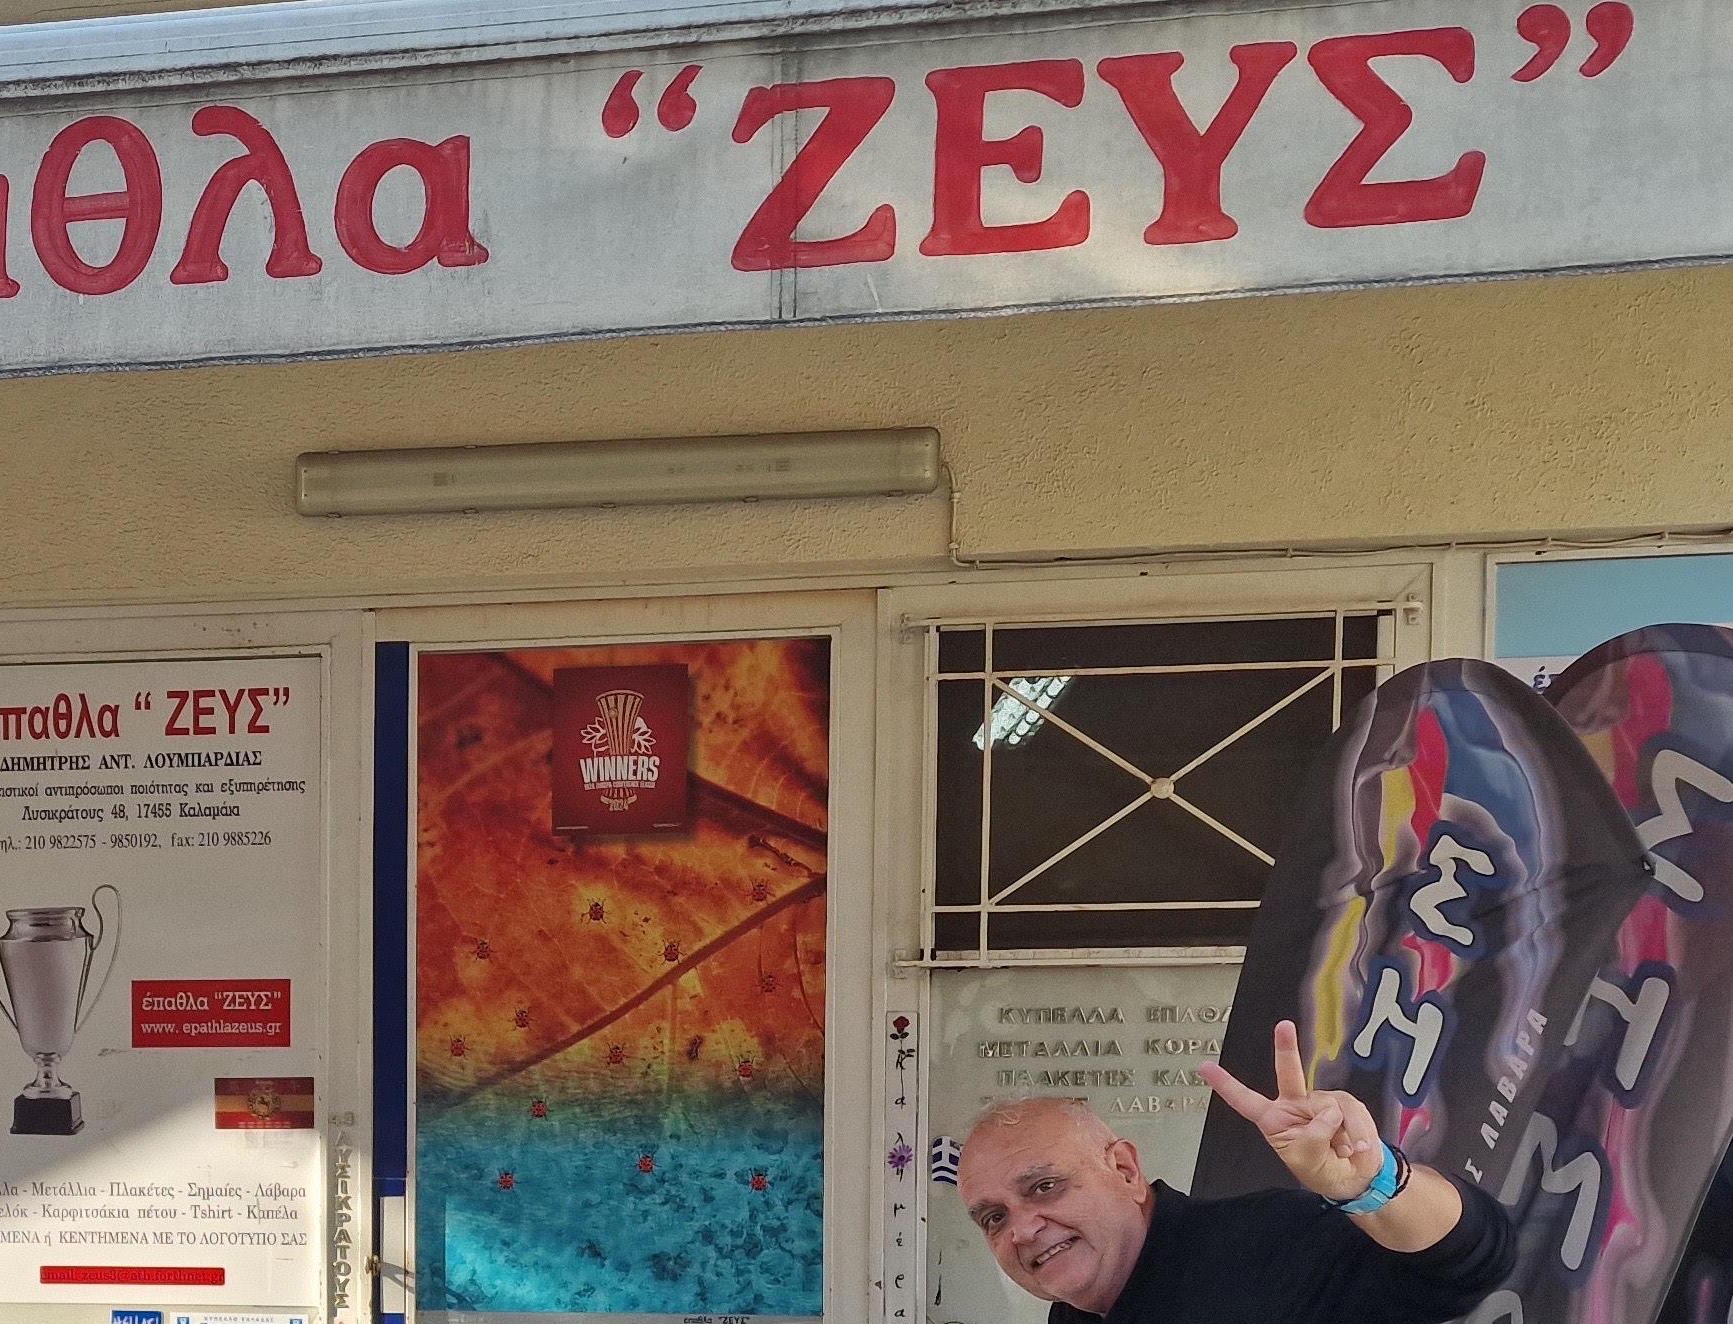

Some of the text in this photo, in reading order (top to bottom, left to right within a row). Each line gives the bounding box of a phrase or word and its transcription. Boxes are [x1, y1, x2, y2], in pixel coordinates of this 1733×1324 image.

[0, 750, 263, 773] ΔΗΜΗΤΡΗΣ ΑΝΤ. ΛΟΥΜΠΑΡΔΙΑΣ
[579, 755, 661, 784] WINNERS
[44, 782, 126, 799] αντιπρόσωποι
[130, 780, 189, 797] ποιότητας
[194, 781, 215, 794] και
[220, 778, 307, 795] εξυπηρέτησης
[21, 804, 105, 823] Λυσικράτους
[110, 803, 129, 820] 48,
[178, 800, 241, 821] Καλαμάκι
[24, 835, 46, 850] 210
[49, 834, 97, 850] 9822575
[170, 832, 195, 849] fax:
[197, 831, 219, 847] 210
[222, 830, 272, 847] 9885226
[140, 990, 209, 1011] έπαθλα
[998, 1006, 1126, 1025] ΚΥΠΕΛΛΑ
[1145, 1038, 1221, 1057] ΚΟΡΔ
[31, 1181, 97, 1197] Μετάλλια
[109, 1181, 176, 1199] Πλακέτες
[186, 1182, 243, 1200] Σημαίες
[254, 1182, 307, 1200] Λάβαρα
[41, 1203, 130, 1223] Καρφιτσάκια
[137, 1203, 178, 1220] πέτου
[190, 1204, 234, 1220] Tshirt
[246, 1205, 300, 1222] Καπέλα
[58, 1230, 150, 1246] ΚΕΝΤΗΜΕΝΑ
[152, 1231, 175, 1246] ΜΕ
[177, 1231, 197, 1246] ΤΟ
[199, 1231, 278, 1247] ΛΟΓΟΤΥΠΟ
[280, 1231, 308, 1247] ΣΑΣ
